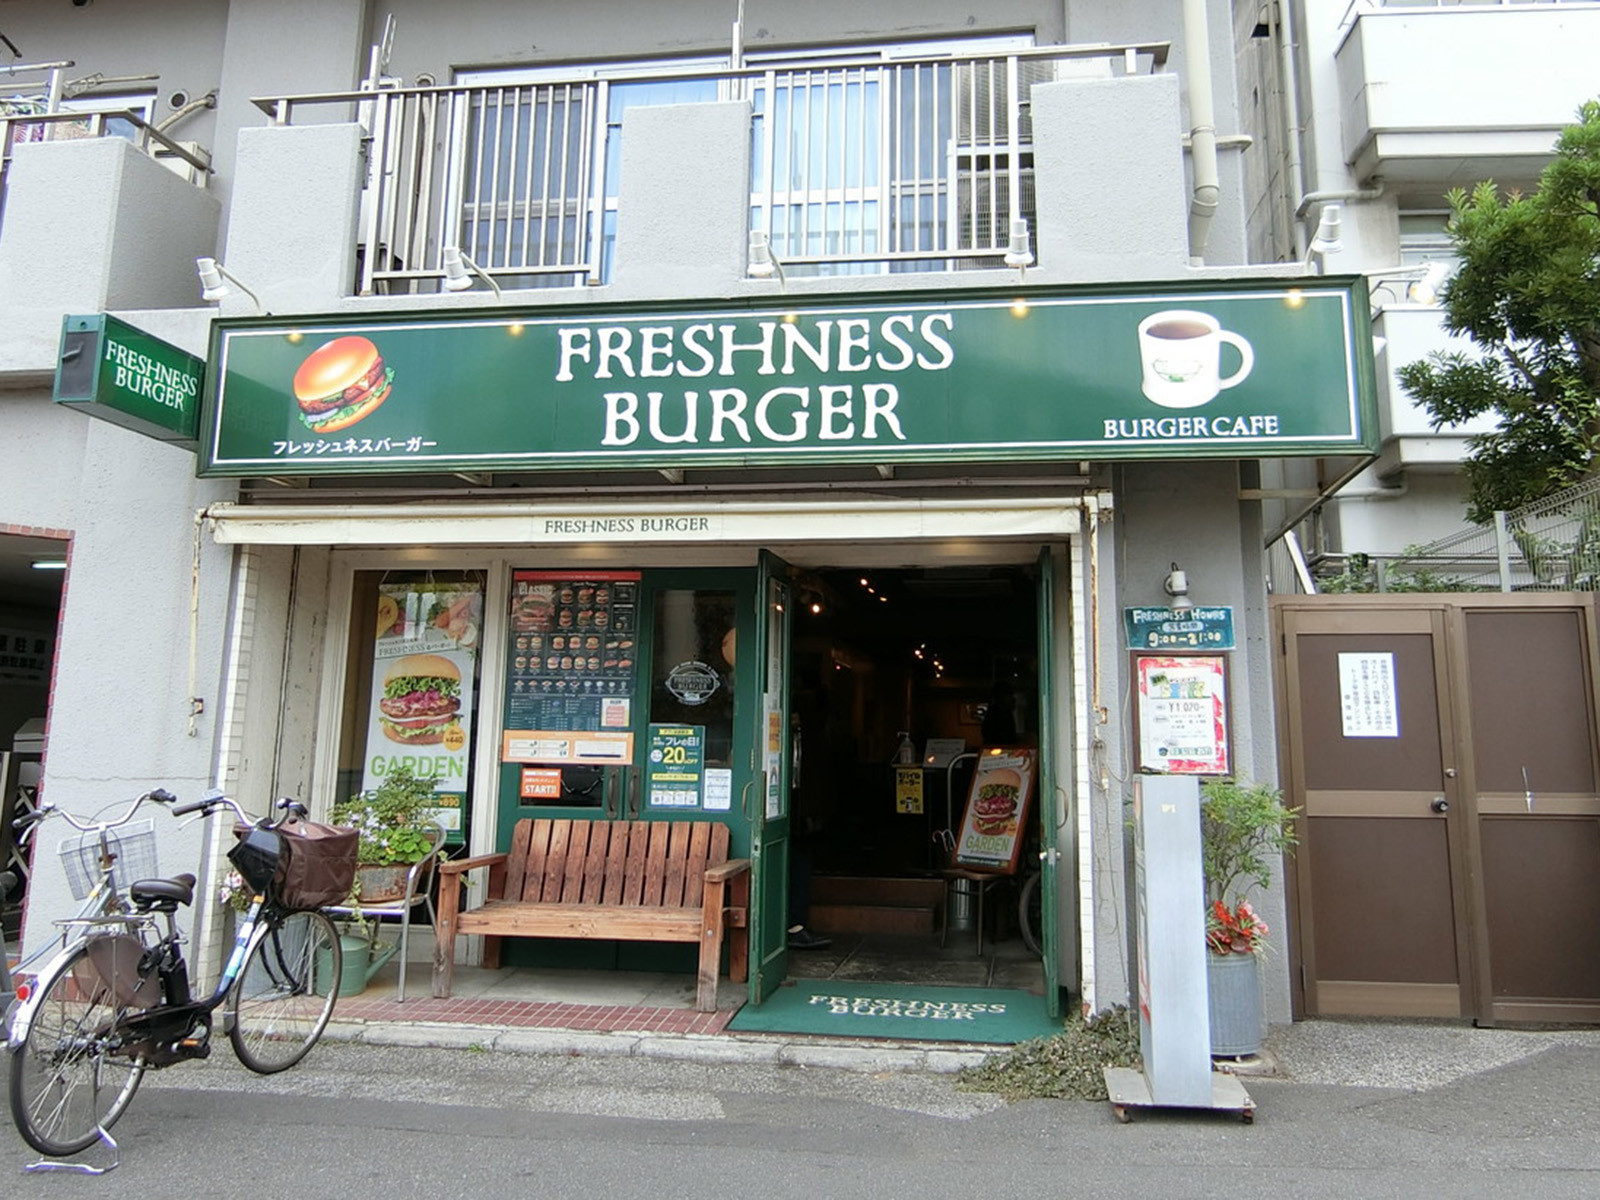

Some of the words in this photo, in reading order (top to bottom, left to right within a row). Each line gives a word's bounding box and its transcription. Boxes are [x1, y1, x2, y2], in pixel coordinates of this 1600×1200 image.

[555, 313, 954, 382] FRESHNESS
[105, 339, 198, 397] FRESHNESS
[115, 365, 184, 412] BURGER
[602, 383, 906, 446] BURGER
[1103, 417, 1209, 438] BURGER
[1211, 415, 1279, 436] CAFE
[273, 437, 437, 455] フレッシュネスバーガー
[544, 518, 635, 534] FRESHNESS
[640, 516, 709, 532] BURGER
[371, 755, 464, 778] GARDEN
[966, 835, 1010, 851] GARDEN
[808, 995, 1007, 1014] FRESHNESS
[828, 1004, 976, 1020] BURGER
